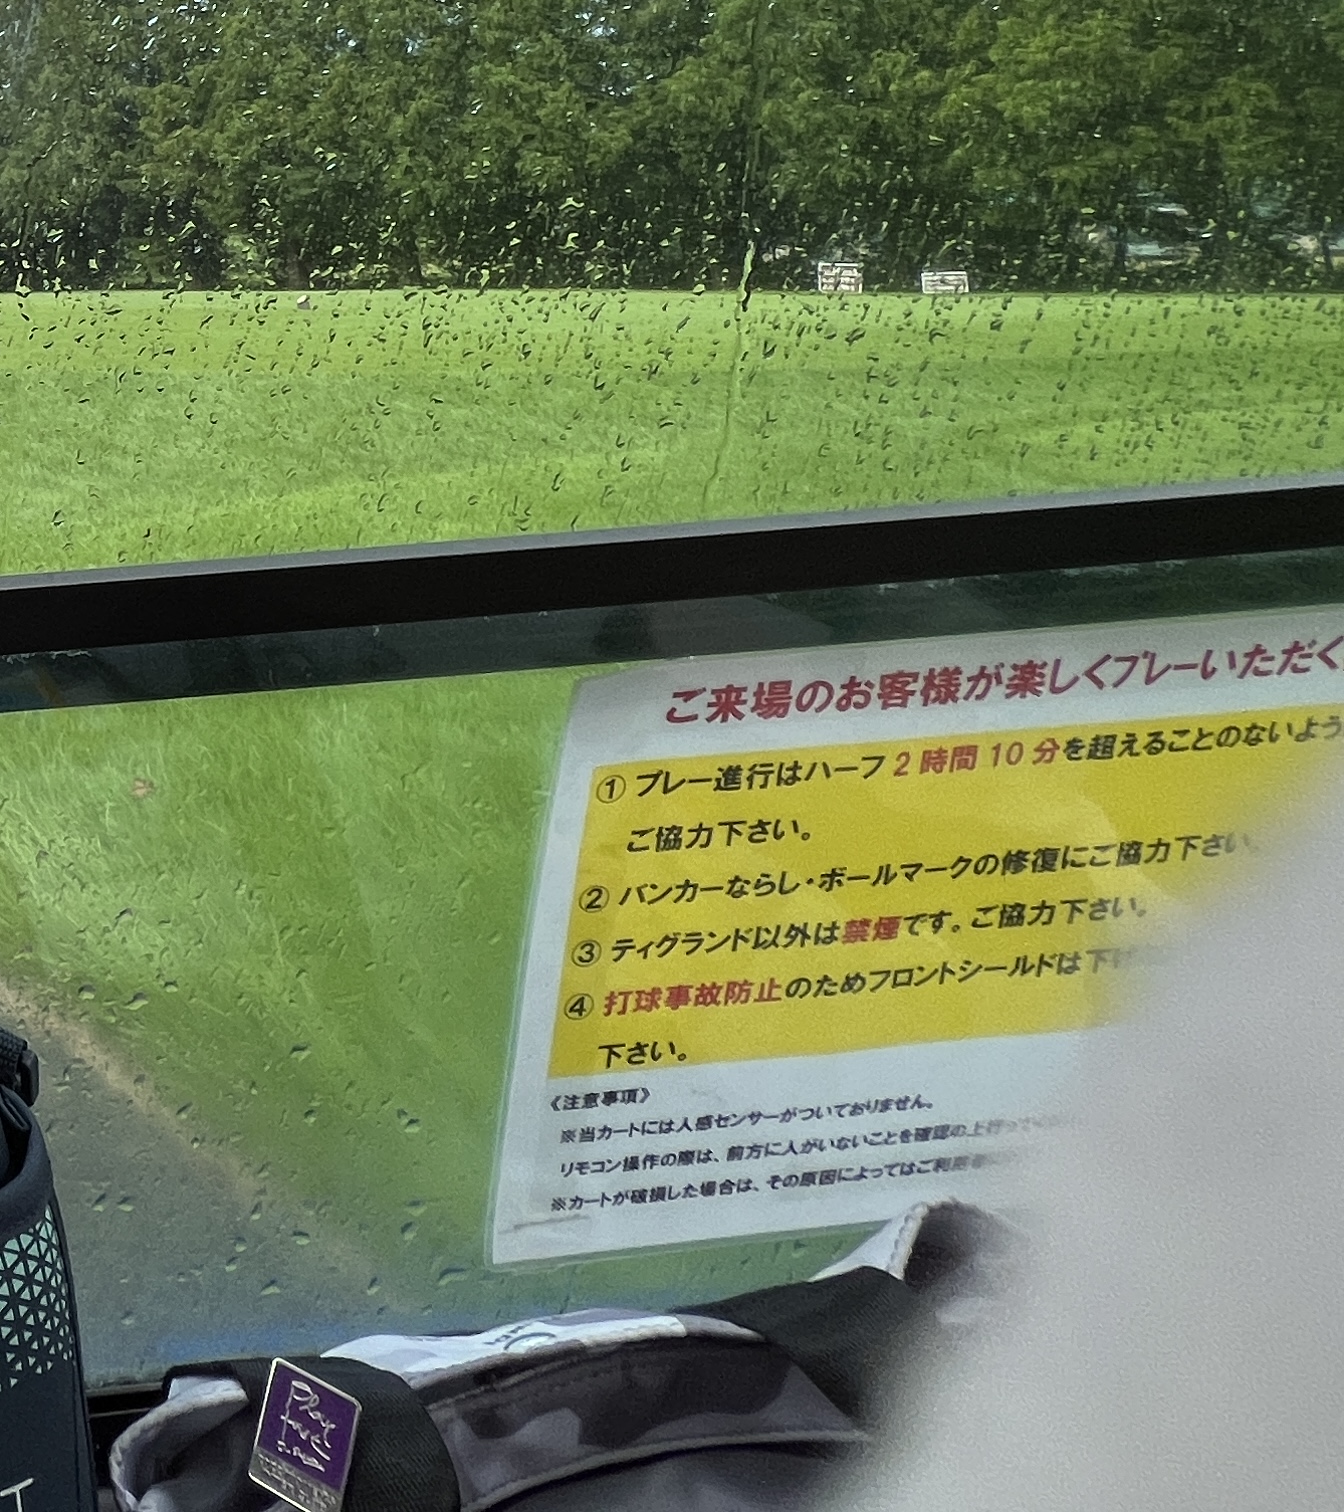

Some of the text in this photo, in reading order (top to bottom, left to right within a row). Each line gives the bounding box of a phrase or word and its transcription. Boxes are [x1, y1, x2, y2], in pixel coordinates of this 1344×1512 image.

[665, 635, 1344, 724] ご来場のお客様が楽しくプレーいただく
[626, 818, 811, 854] ご協力下さい。
[598, 1041, 688, 1069] 下さい。
